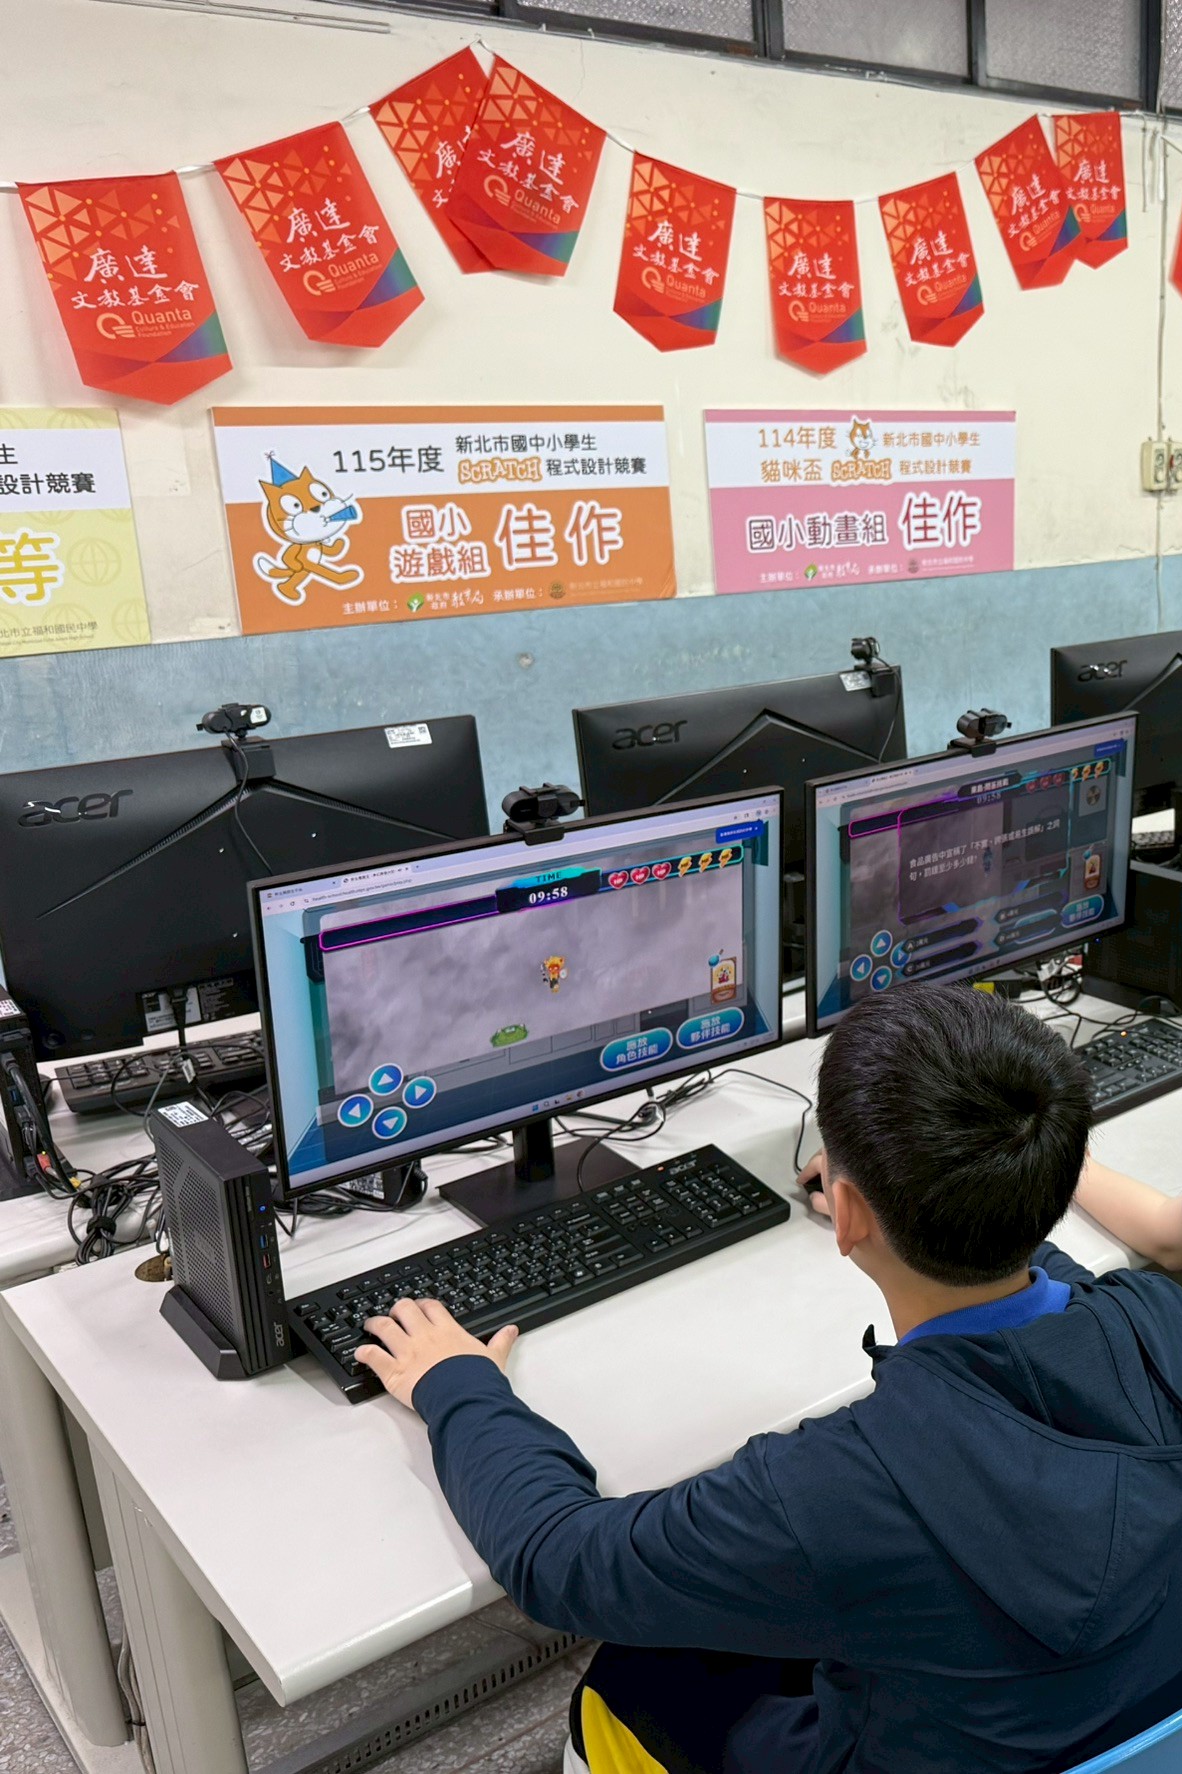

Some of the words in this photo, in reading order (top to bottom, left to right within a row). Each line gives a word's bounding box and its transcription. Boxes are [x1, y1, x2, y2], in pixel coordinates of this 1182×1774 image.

[501, 131, 565, 186] 廣達
[477, 149, 579, 214] 文教基金會
[286, 197, 351, 243] 廣達
[514, 188, 561, 225] Quanta
[280, 224, 379, 272] 文教基金會
[647, 219, 702, 262] 廣達
[84, 244, 168, 284] 廣達
[328, 252, 379, 278] Quanta
[787, 251, 836, 279] 廣達
[71, 280, 199, 309] 文教基金會
[131, 308, 192, 325] Quanta
[333, 445, 445, 474] 115年度
[455, 433, 597, 453] 新北市國中小學生
[758, 426, 837, 449] 114年度
[882, 431, 981, 448] 新北市國中小學生
[546, 457, 647, 475] 程式設計競賽
[761, 458, 822, 483] 貓咪盃
[899, 459, 972, 475] 程式設計競賽
[404, 505, 470, 540] 國小
[497, 504, 621, 566] 佳作
[748, 513, 887, 551] 國小動畫組
[901, 494, 979, 547] 佳作
[393, 544, 488, 580] 遊戲組
[1077, 660, 1127, 682] acer
[611, 719, 688, 750] acer
[17, 789, 133, 828] acer
[536, 871, 562, 883] TIME
[528, 886, 568, 904] 09:58
[274, 1322, 285, 1347] acer
